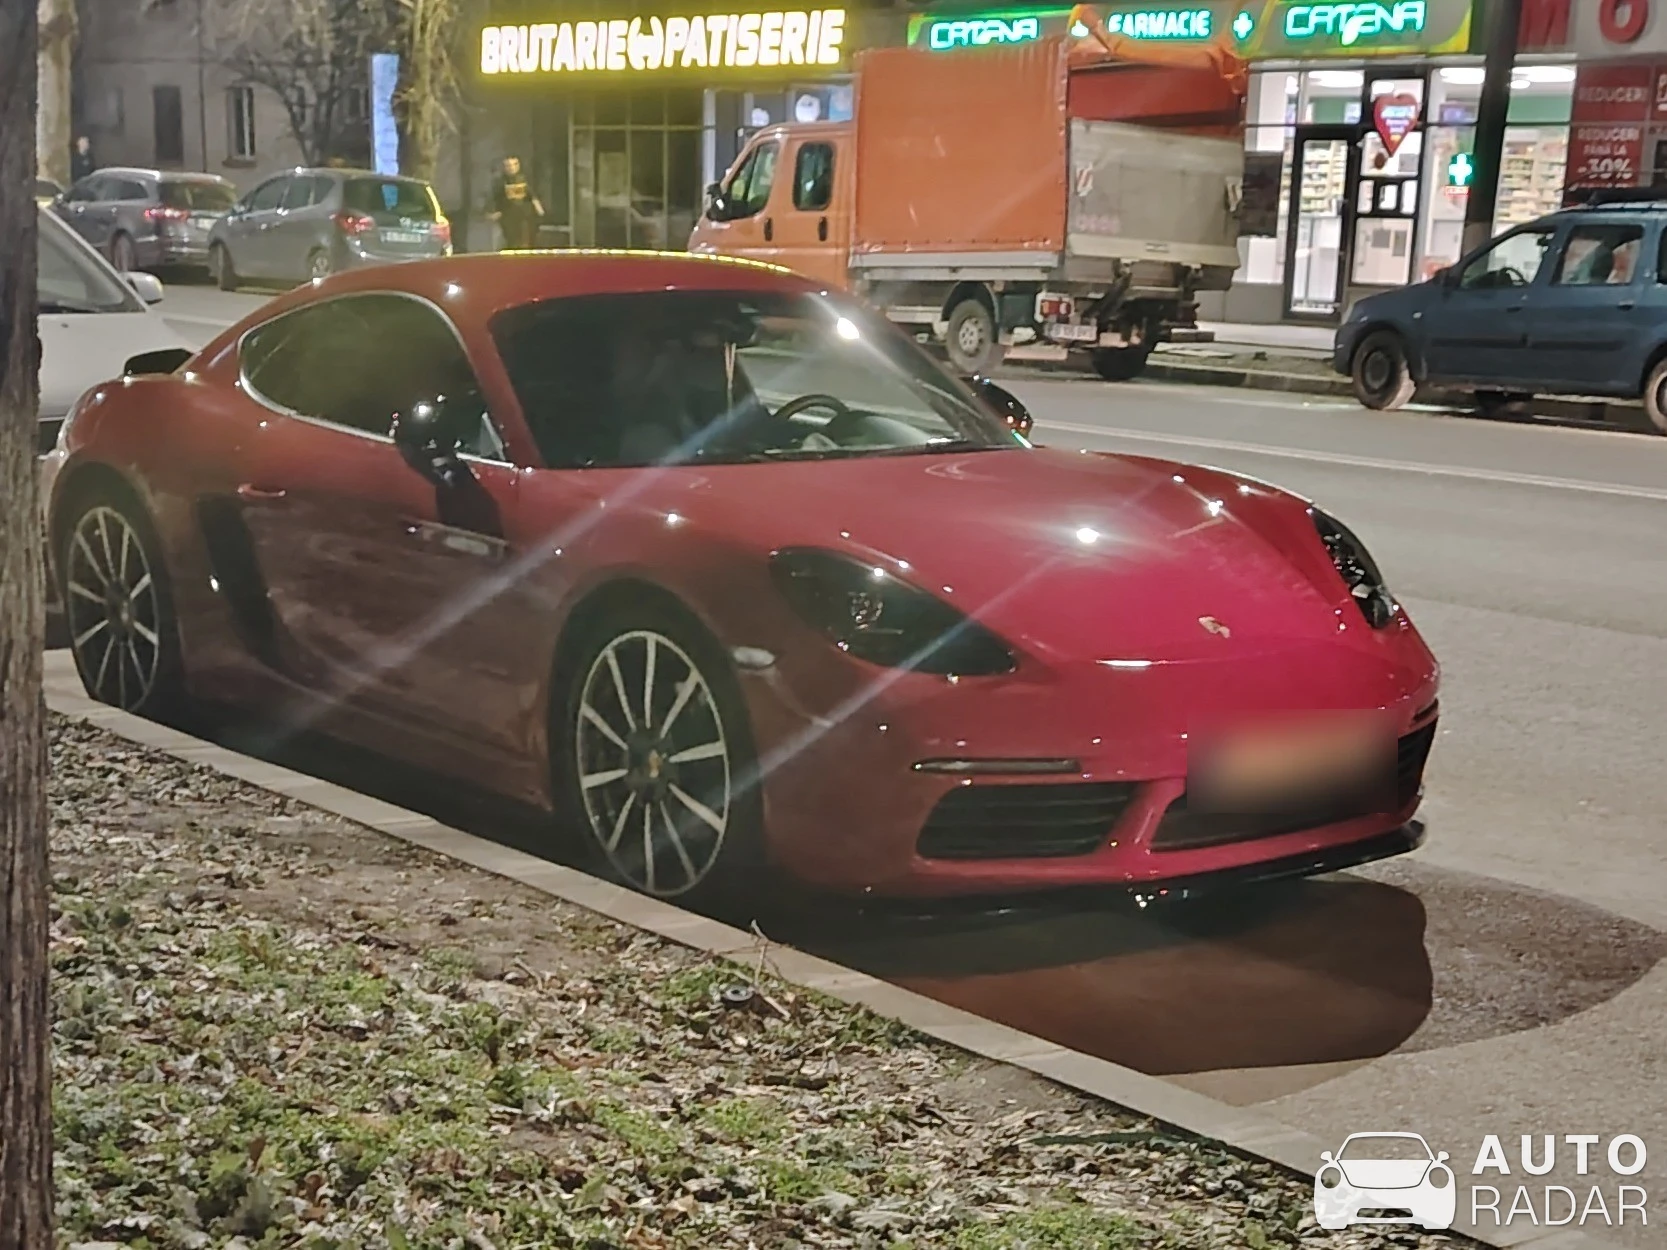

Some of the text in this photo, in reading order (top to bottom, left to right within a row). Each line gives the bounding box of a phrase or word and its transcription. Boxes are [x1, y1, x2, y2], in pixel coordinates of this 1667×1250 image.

[481, 9, 846, 74] BRUTARIE PATISERIE
[930, 17, 1039, 49] CATENA
[1108, 10, 1211, 38] FARMACIE
[1286, 1, 1425, 46] CATENA
